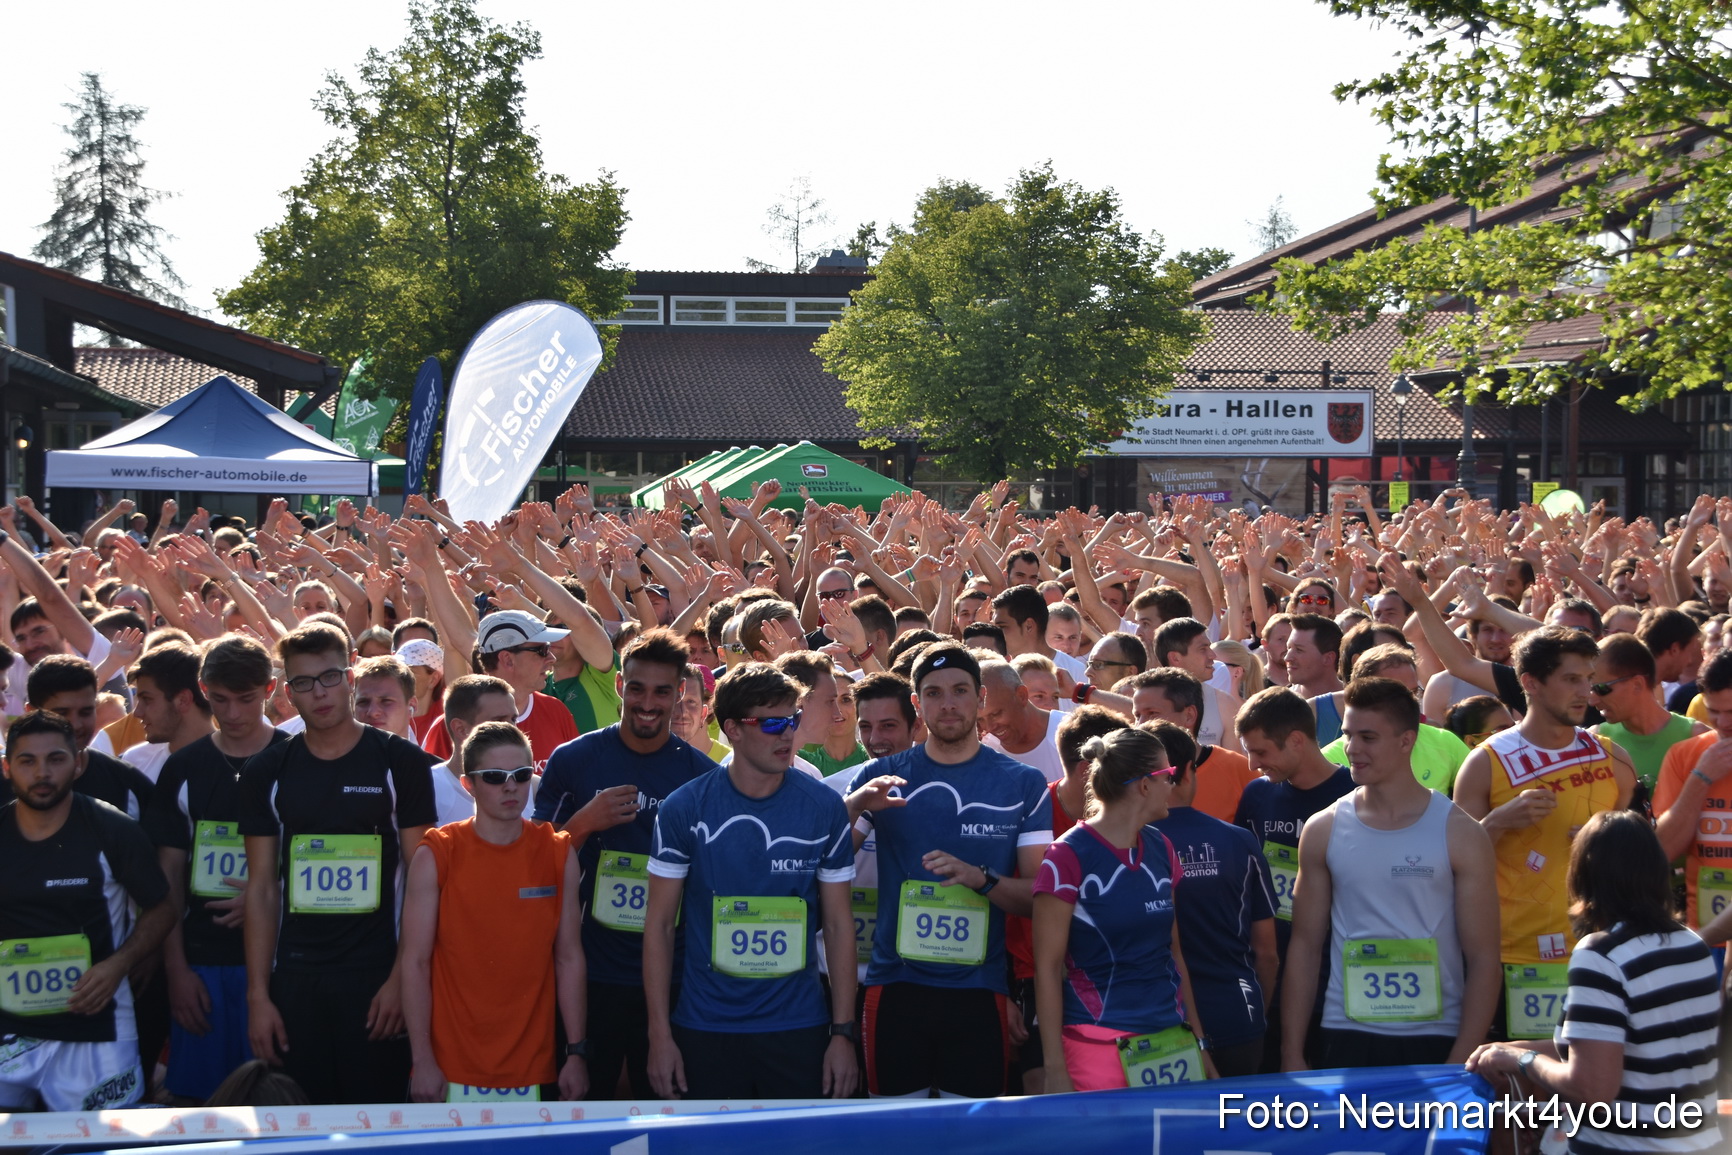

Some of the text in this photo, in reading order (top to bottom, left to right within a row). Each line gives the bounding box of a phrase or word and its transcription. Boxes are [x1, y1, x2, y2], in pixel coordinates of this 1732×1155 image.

[481, 330, 567, 465] Fischer
[512, 354, 578, 462] AUTOMOBILE
[1226, 400, 1313, 418] Hallen
[1145, 437, 1178, 445] wünscht
[1180, 437, 1201, 445] Ihnen
[1228, 438, 1278, 447] angenehmen
[1281, 437, 1324, 446] Aufenthalt!
[1152, 428, 1173, 436] Stadt
[1175, 428, 1213, 436] Neumarkt
[1222, 428, 1229, 436] d.
[1232, 428, 1248, 436] OPf.
[1250, 428, 1272, 438] grüßt
[1274, 428, 1289, 436] ihre
[1291, 428, 1314, 436] Gäste
[110, 465, 308, 483] www.fischer-automobile.de
[1150, 468, 1213, 482] Willkommen
[1164, 480, 1218, 492] in meinem
[1706, 798, 1725, 809] 30
[962, 823, 994, 835] MCM
[1264, 820, 1294, 833] EURO
[771, 859, 803, 871] MCM
[300, 866, 368, 891] 1081
[611, 883, 649, 910] 38
[1145, 900, 1166, 912] MCM
[916, 913, 969, 941] 958
[731, 929, 787, 956] 956
[919, 943, 964, 953] Thomas Schmidt
[7, 966, 82, 995] 1089
[1363, 972, 1421, 998] 353
[1141, 1058, 1190, 1086] 952
